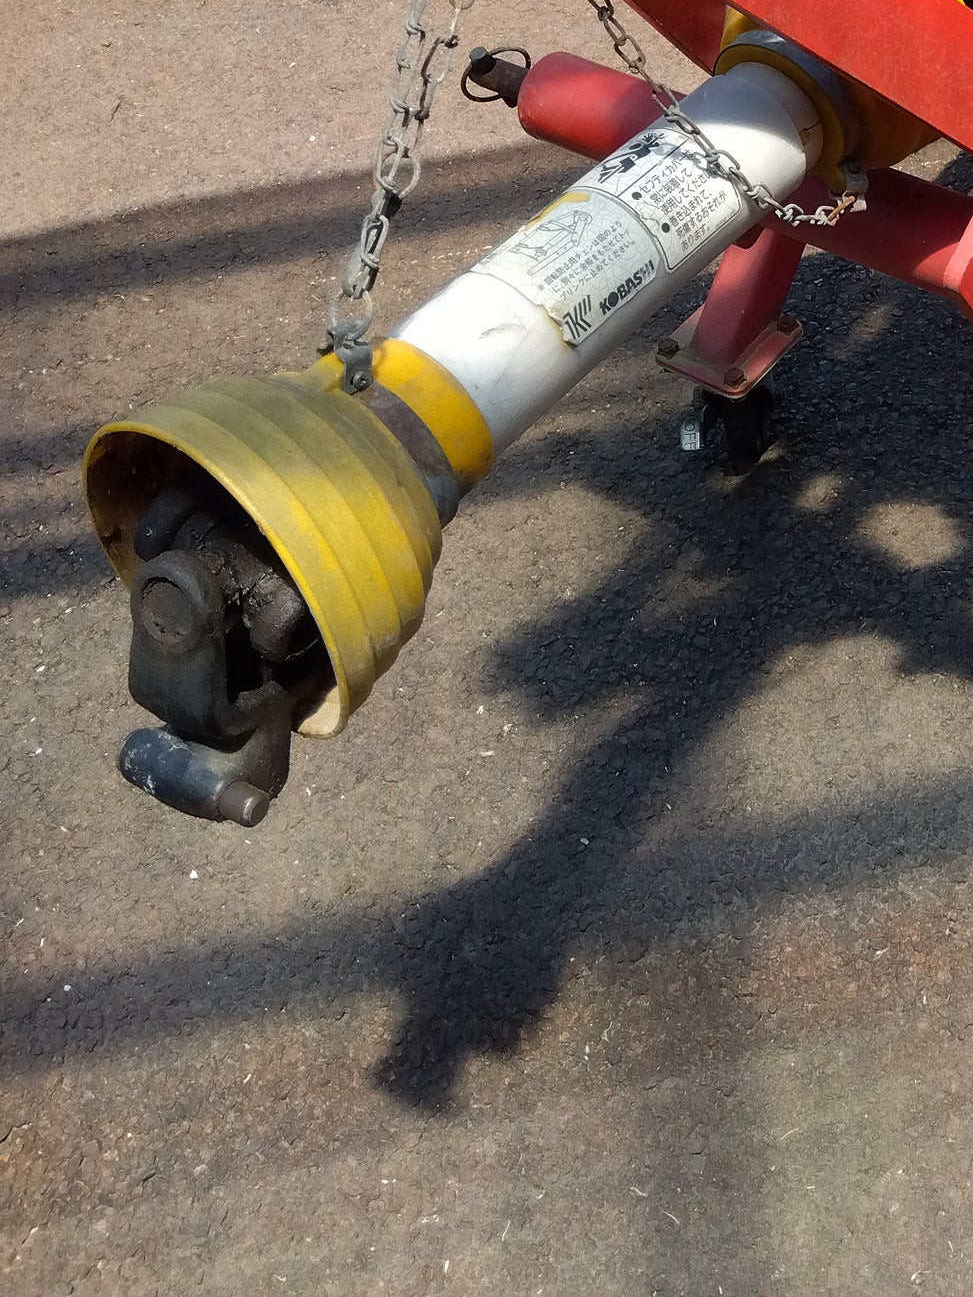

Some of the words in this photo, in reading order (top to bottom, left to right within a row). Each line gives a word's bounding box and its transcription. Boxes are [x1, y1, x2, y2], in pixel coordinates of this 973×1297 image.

[649, 166, 692, 205] 常に装着して
[667, 187, 712, 228] 巻き込まれて、
[675, 190, 727, 240] 死傷するおそれが
[679, 222, 711, 253] あります。
[598, 259, 656, 316] KOBASHI
